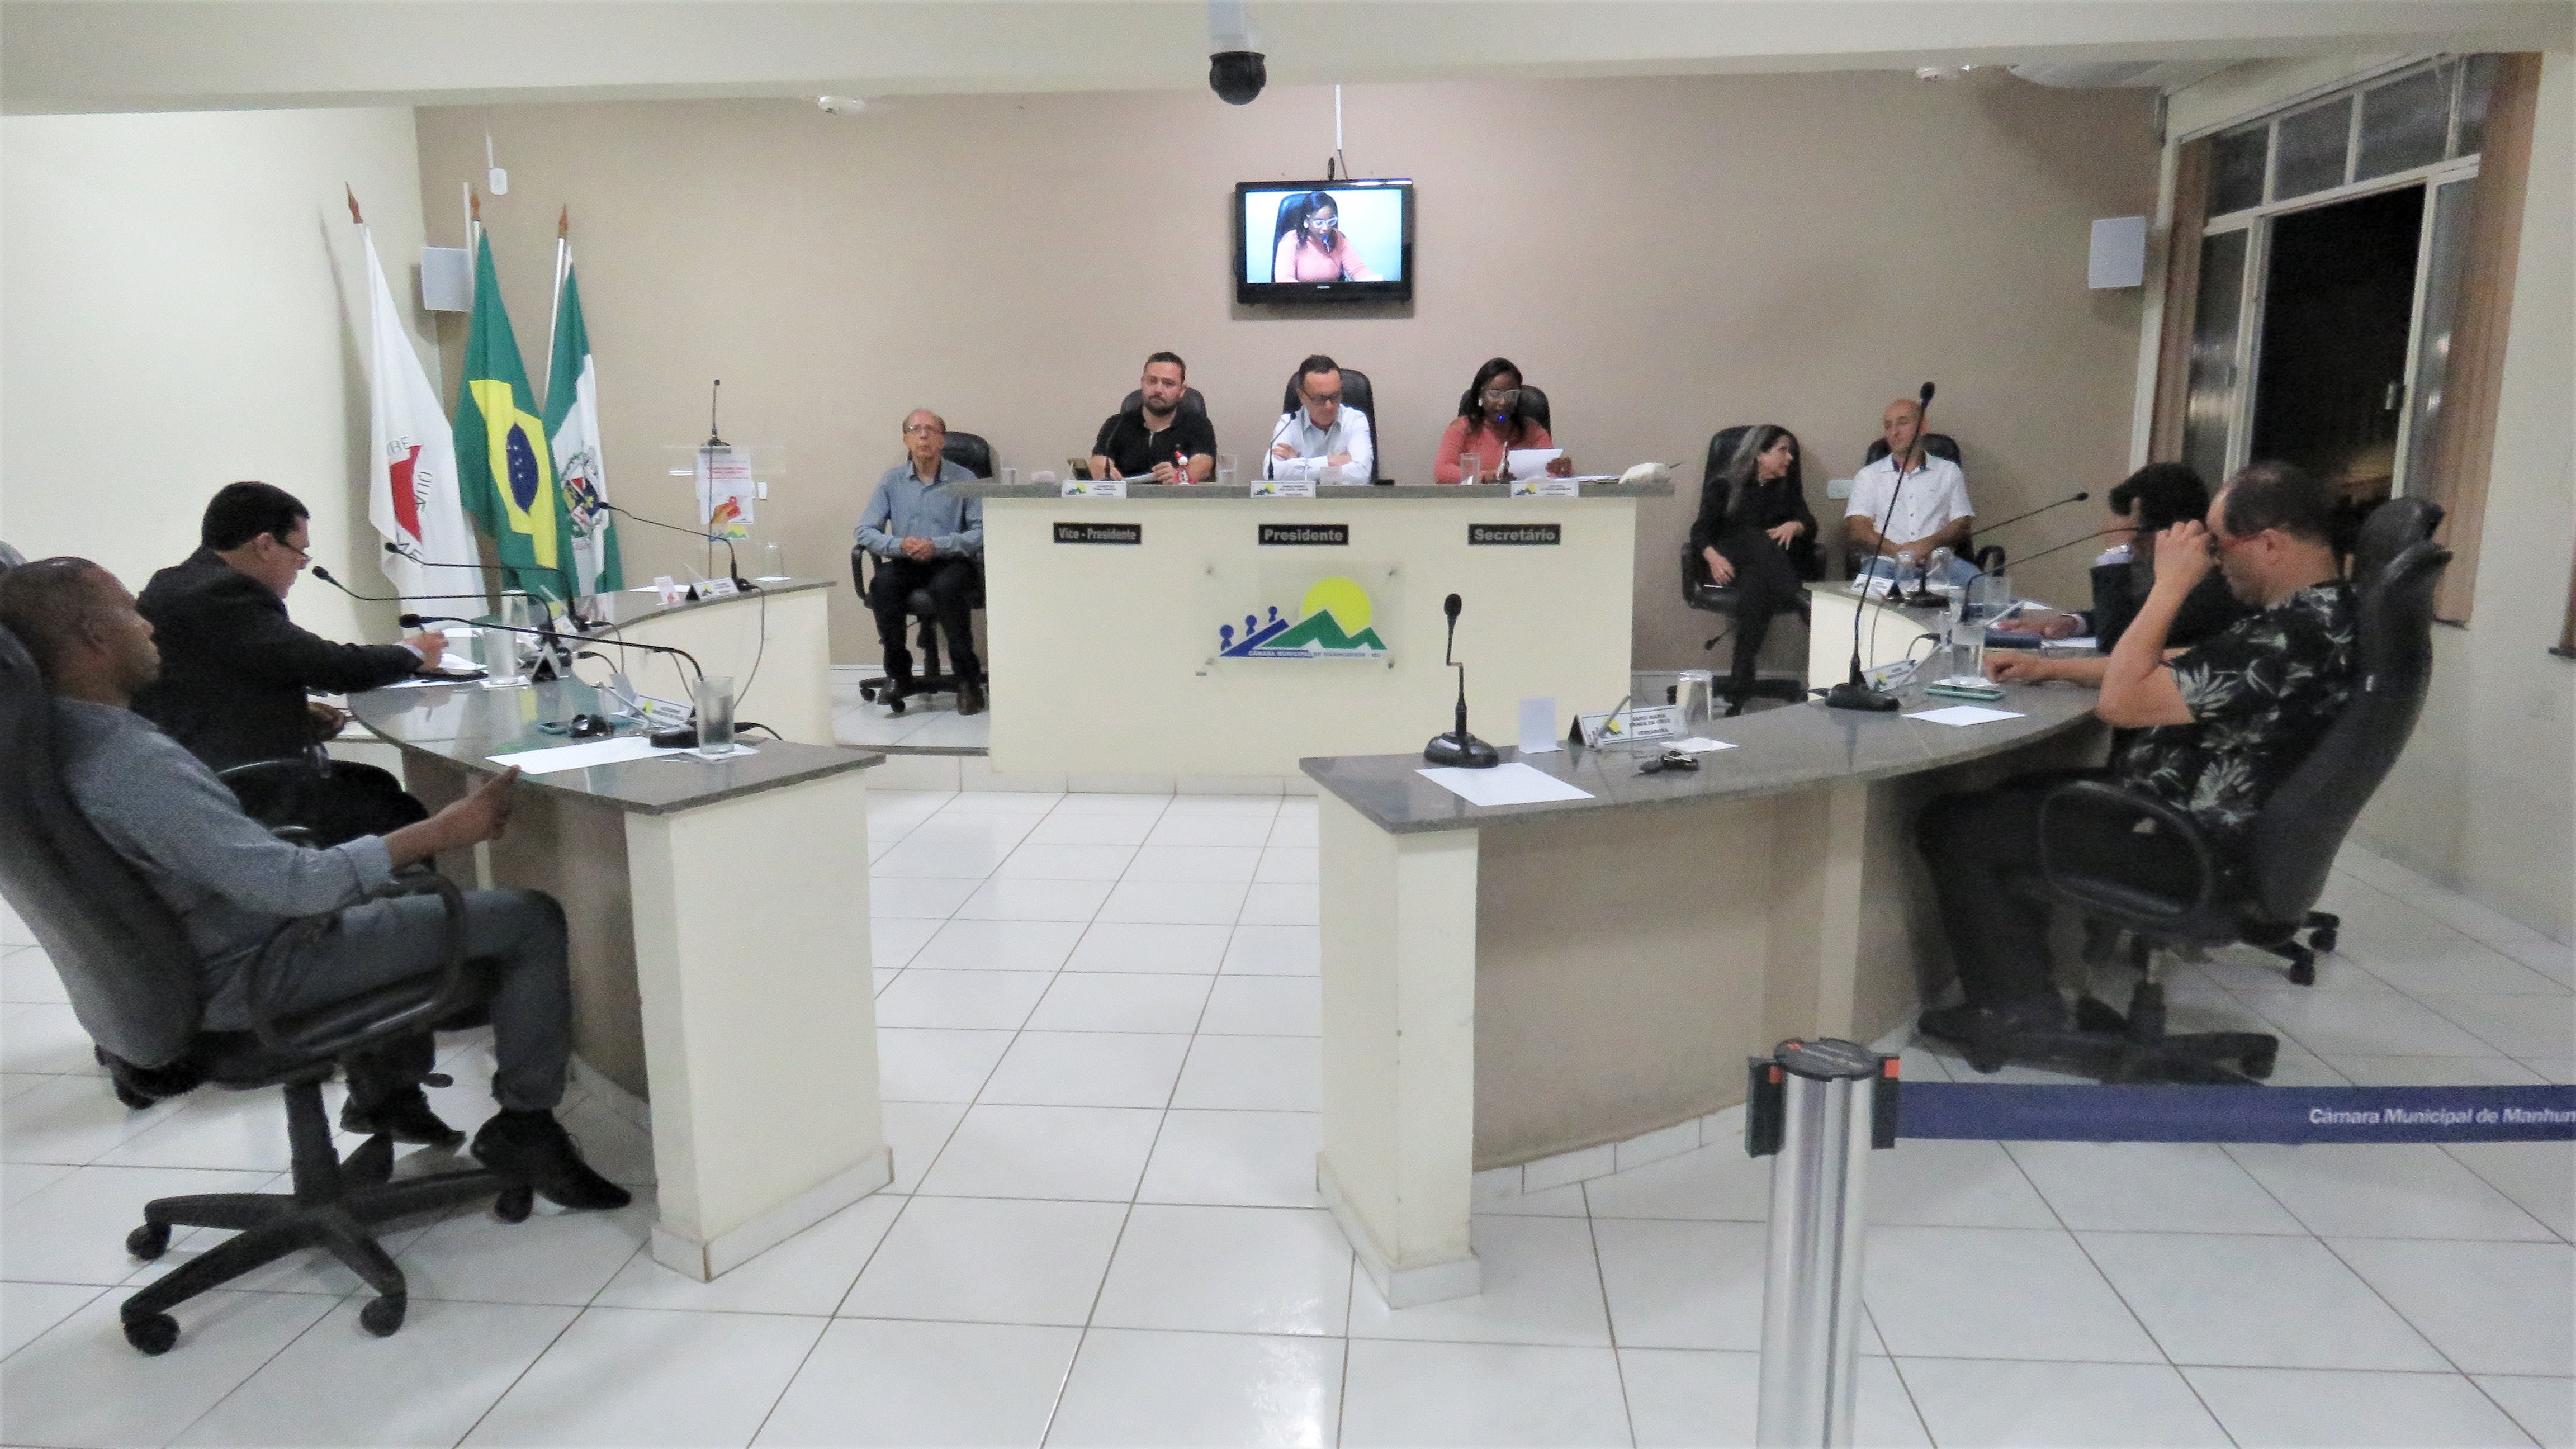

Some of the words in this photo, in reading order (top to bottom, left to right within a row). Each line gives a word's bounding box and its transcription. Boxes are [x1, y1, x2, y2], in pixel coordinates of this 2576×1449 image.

[1058, 527, 1079, 539] Vice
[1087, 527, 1137, 540] Presidente
[1264, 528, 1343, 541] Presidente
[1474, 528, 1555, 541] Secretário
[2309, 1108, 2380, 1124] Câmara
[2384, 1108, 2474, 1126] Municipal
[2476, 1108, 2498, 1123] de
